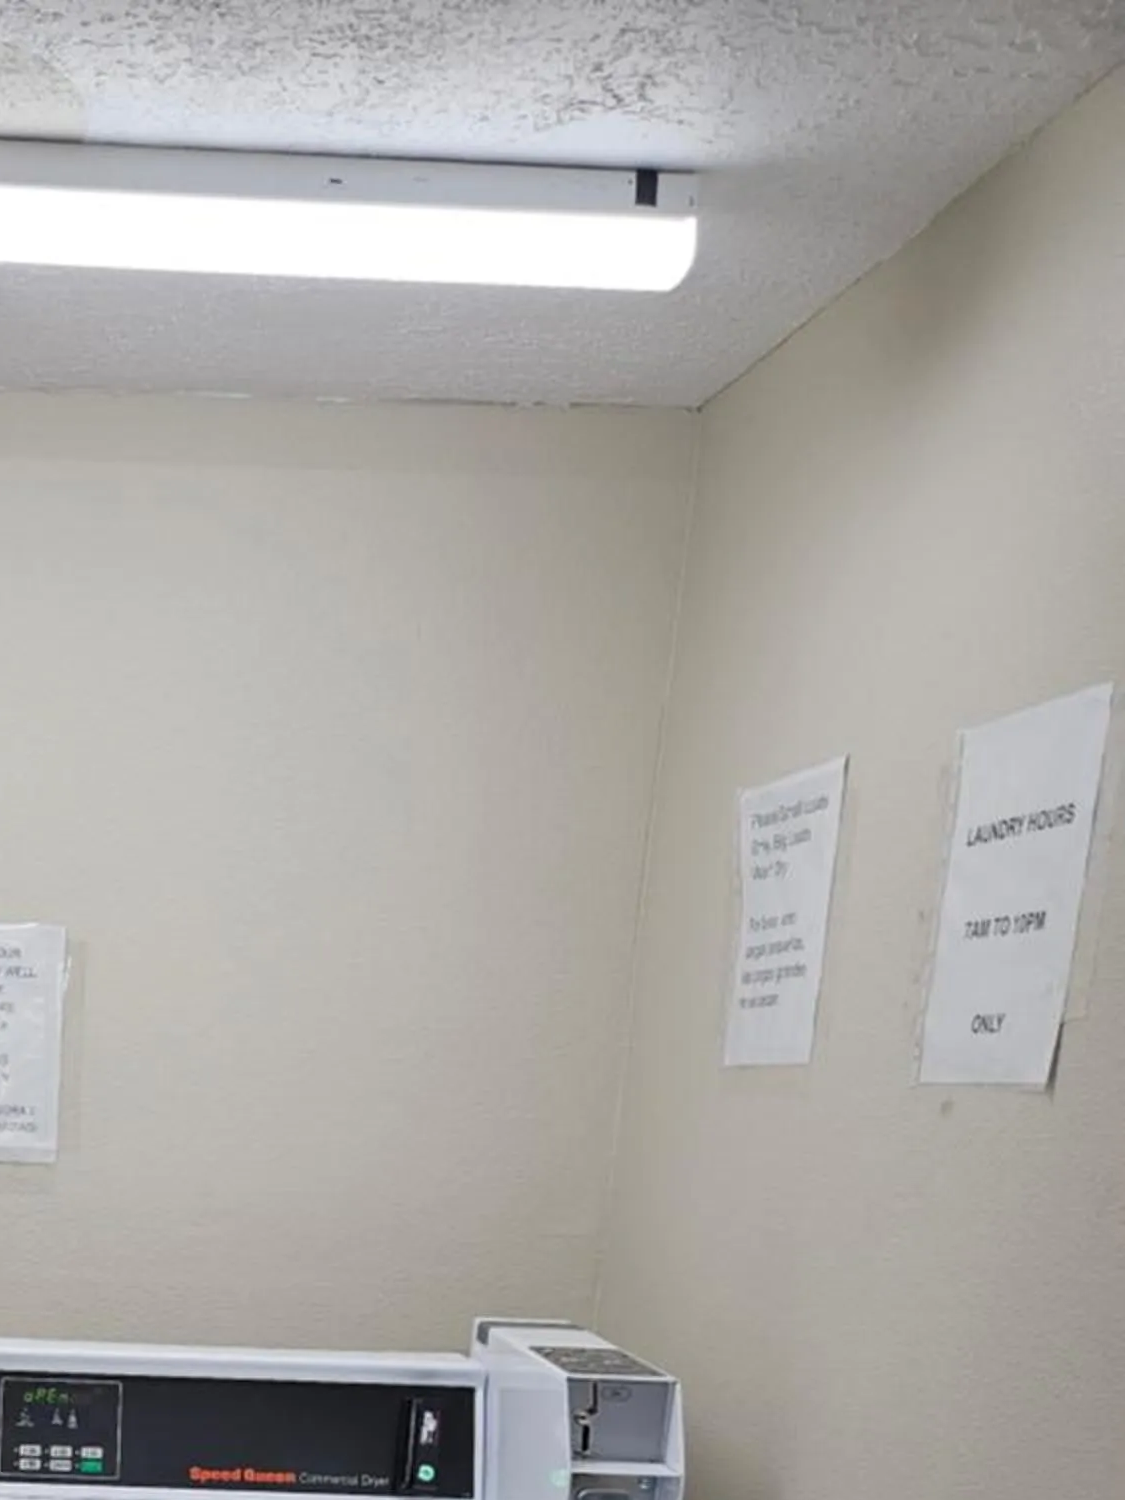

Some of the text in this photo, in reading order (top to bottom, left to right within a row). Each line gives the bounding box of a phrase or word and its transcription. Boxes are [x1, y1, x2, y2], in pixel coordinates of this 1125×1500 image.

[966, 802, 1077, 847] LAUNDRY HOURS
[964, 910, 1047, 940] 7AM TO 10PM
[971, 1013, 1006, 1034] ONLY
[189, 1465, 391, 1490] Speed Queen Commercial Dryer
